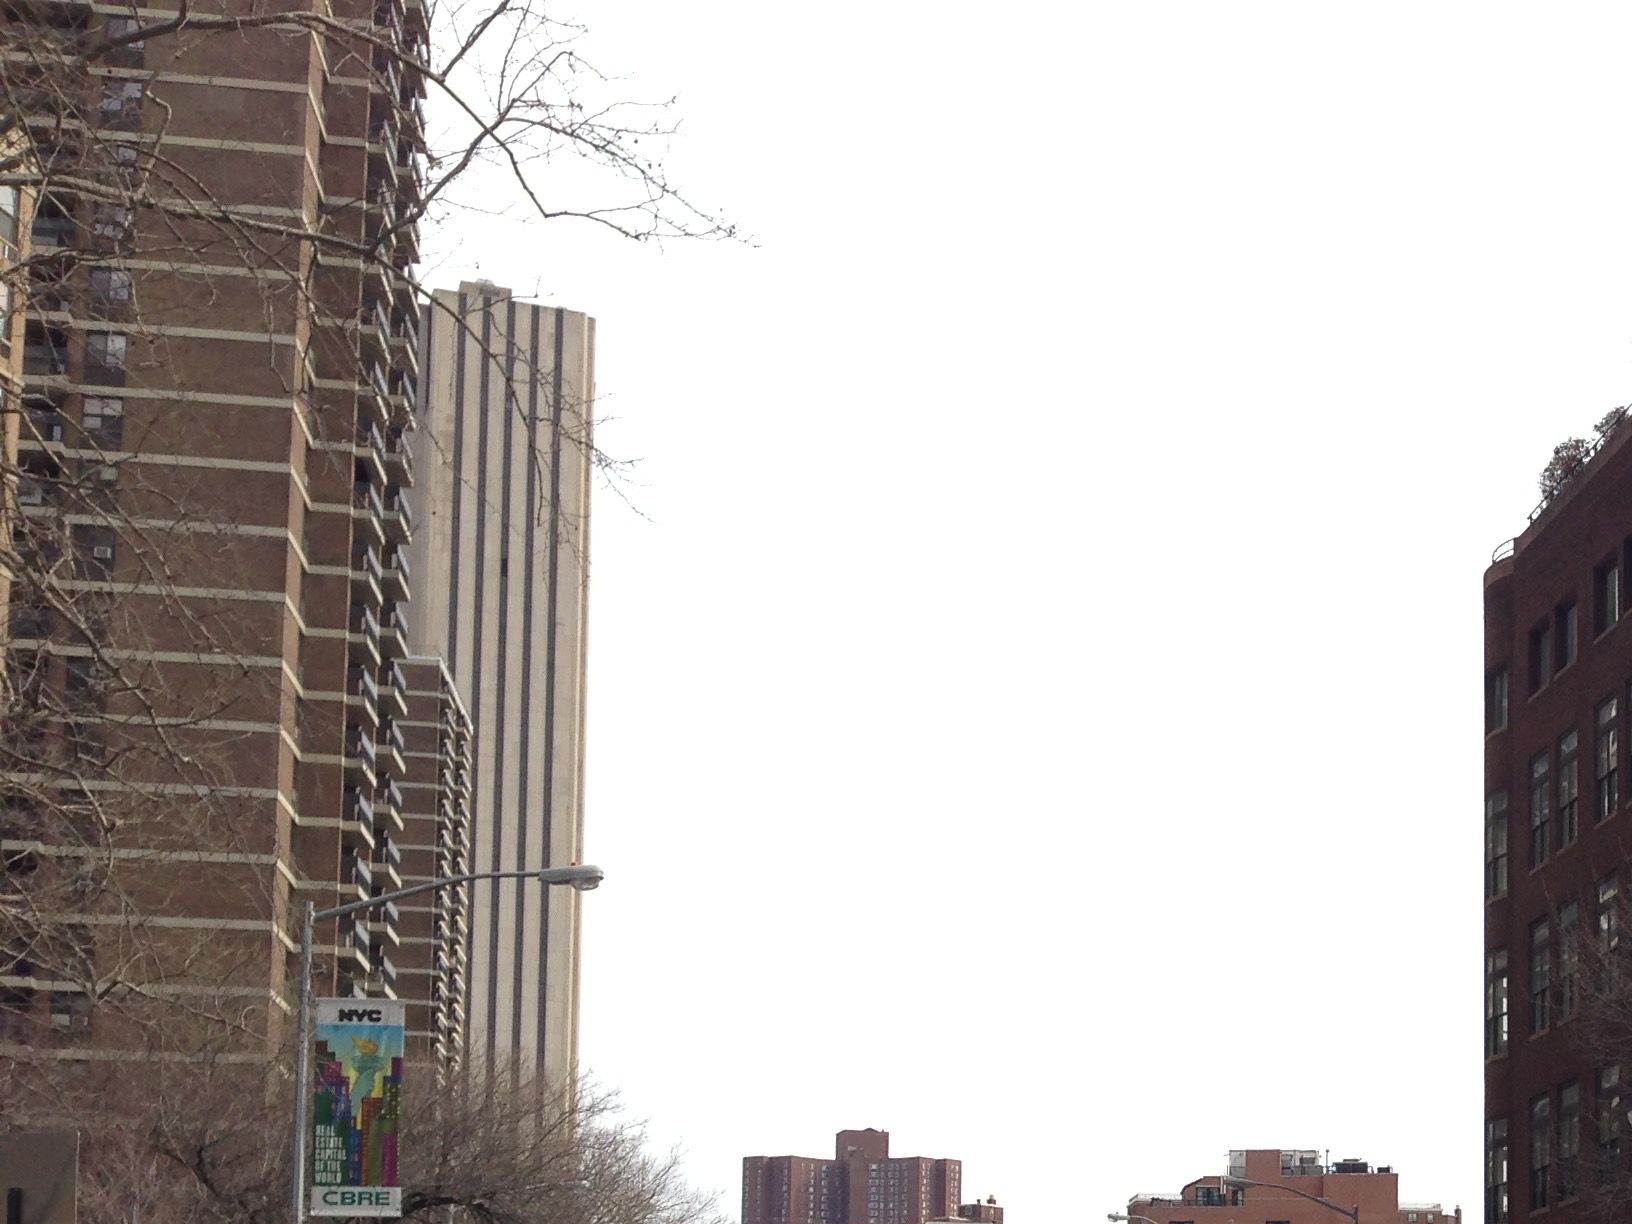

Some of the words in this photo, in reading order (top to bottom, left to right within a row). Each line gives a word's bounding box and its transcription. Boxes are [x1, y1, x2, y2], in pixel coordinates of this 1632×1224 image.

[338, 1009, 382, 1022] NYC
[315, 1125, 335, 1136] REAL
[315, 1137, 343, 1148] ESTATE
[315, 1149, 347, 1160] CAPITAL
[315, 1161, 325, 1172] OF
[327, 1161, 341, 1172] THE
[315, 1172, 342, 1184] WORLD
[322, 1191, 391, 1206] CBRE
